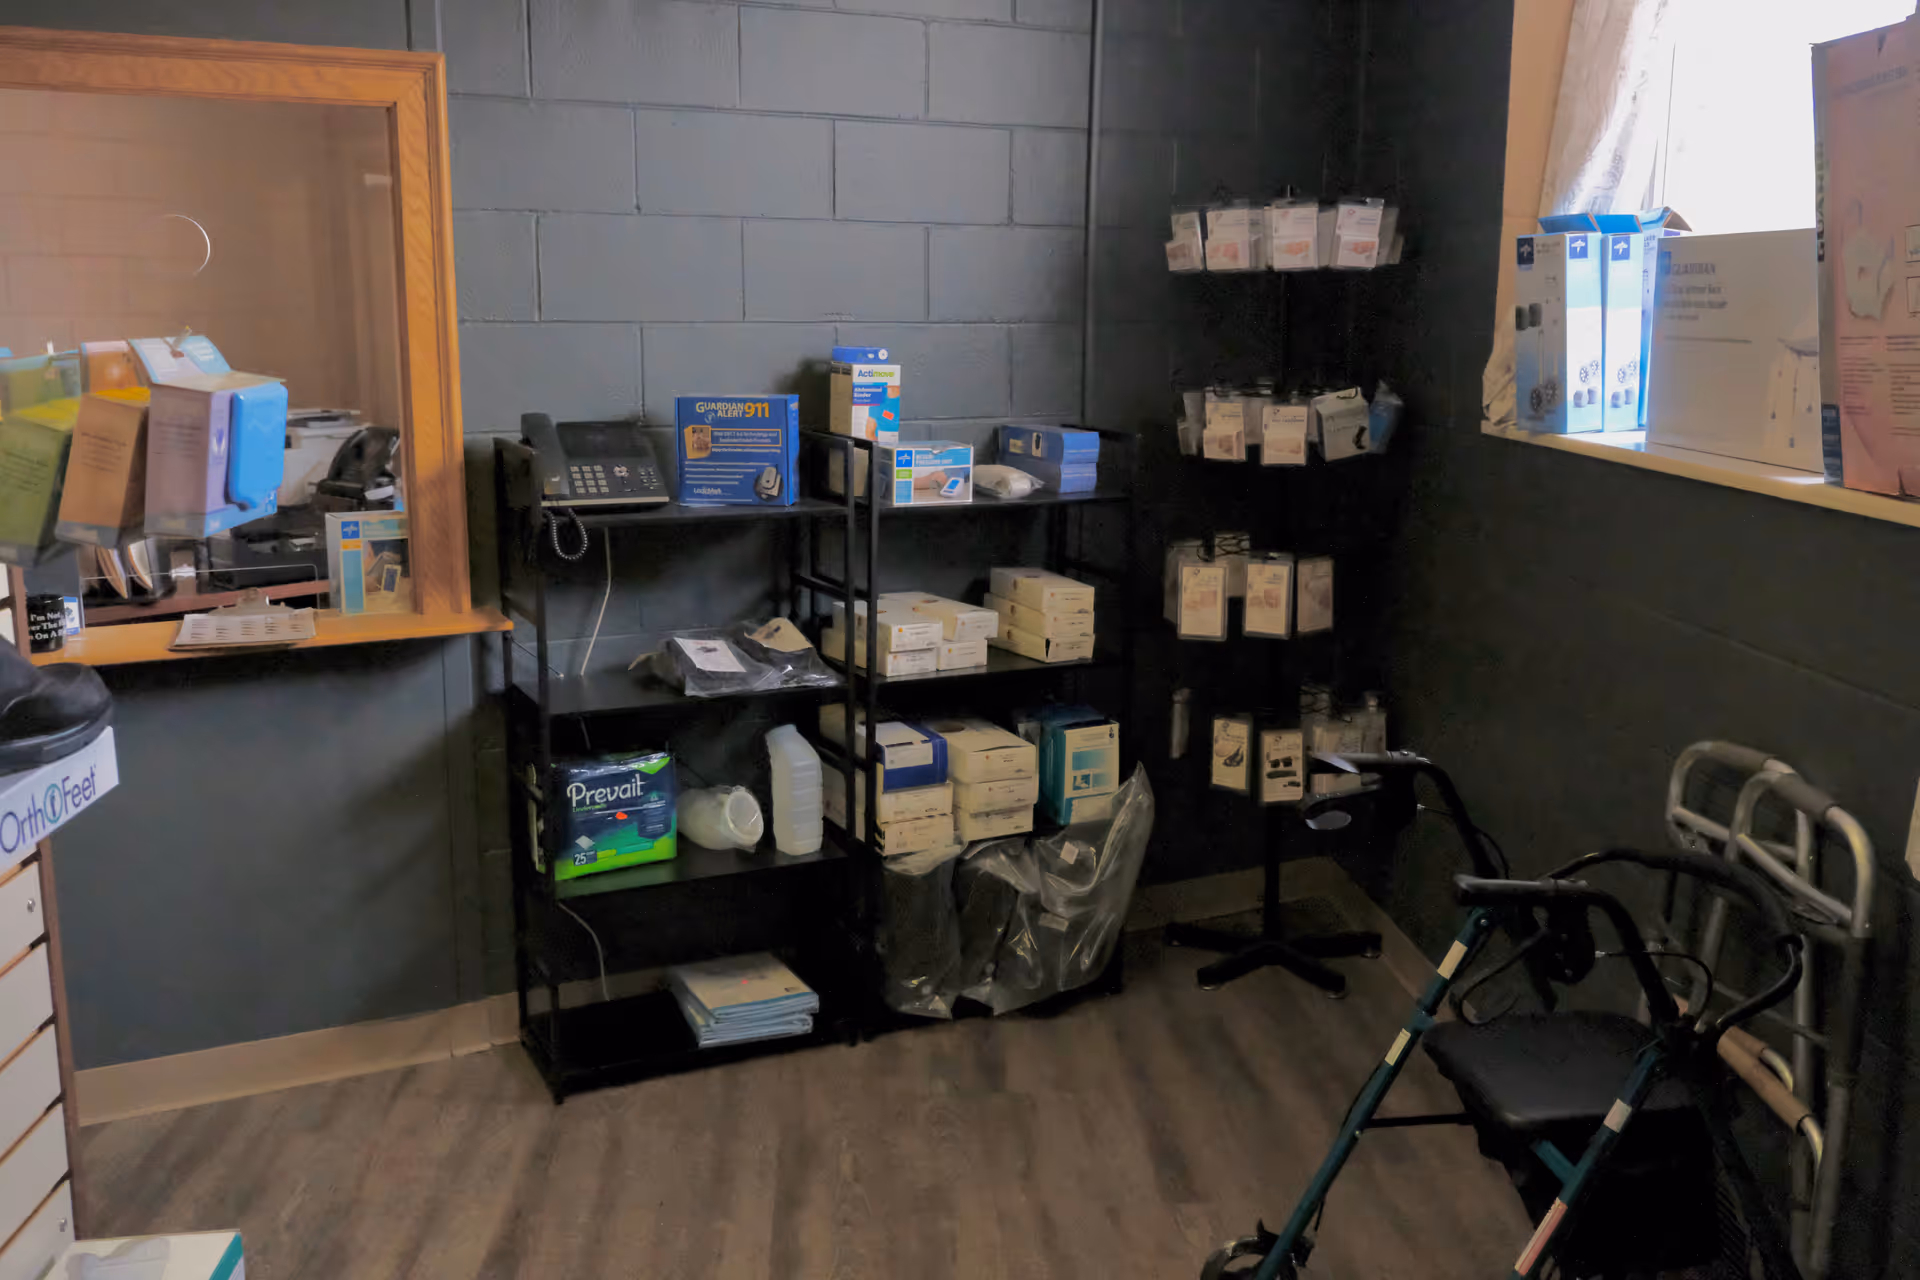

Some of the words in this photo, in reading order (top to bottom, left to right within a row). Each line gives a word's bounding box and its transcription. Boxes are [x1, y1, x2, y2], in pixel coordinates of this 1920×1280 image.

[858, 368, 894, 377] Actimove
[696, 401, 743, 413] GUARDIAN
[744, 402, 769, 417] 911
[30, 614, 45, 622] I'm
[41, 622, 57, 630] The
[35, 632, 49, 640] On
[50, 630, 57, 638] A
[573, 852, 587, 865] 25
